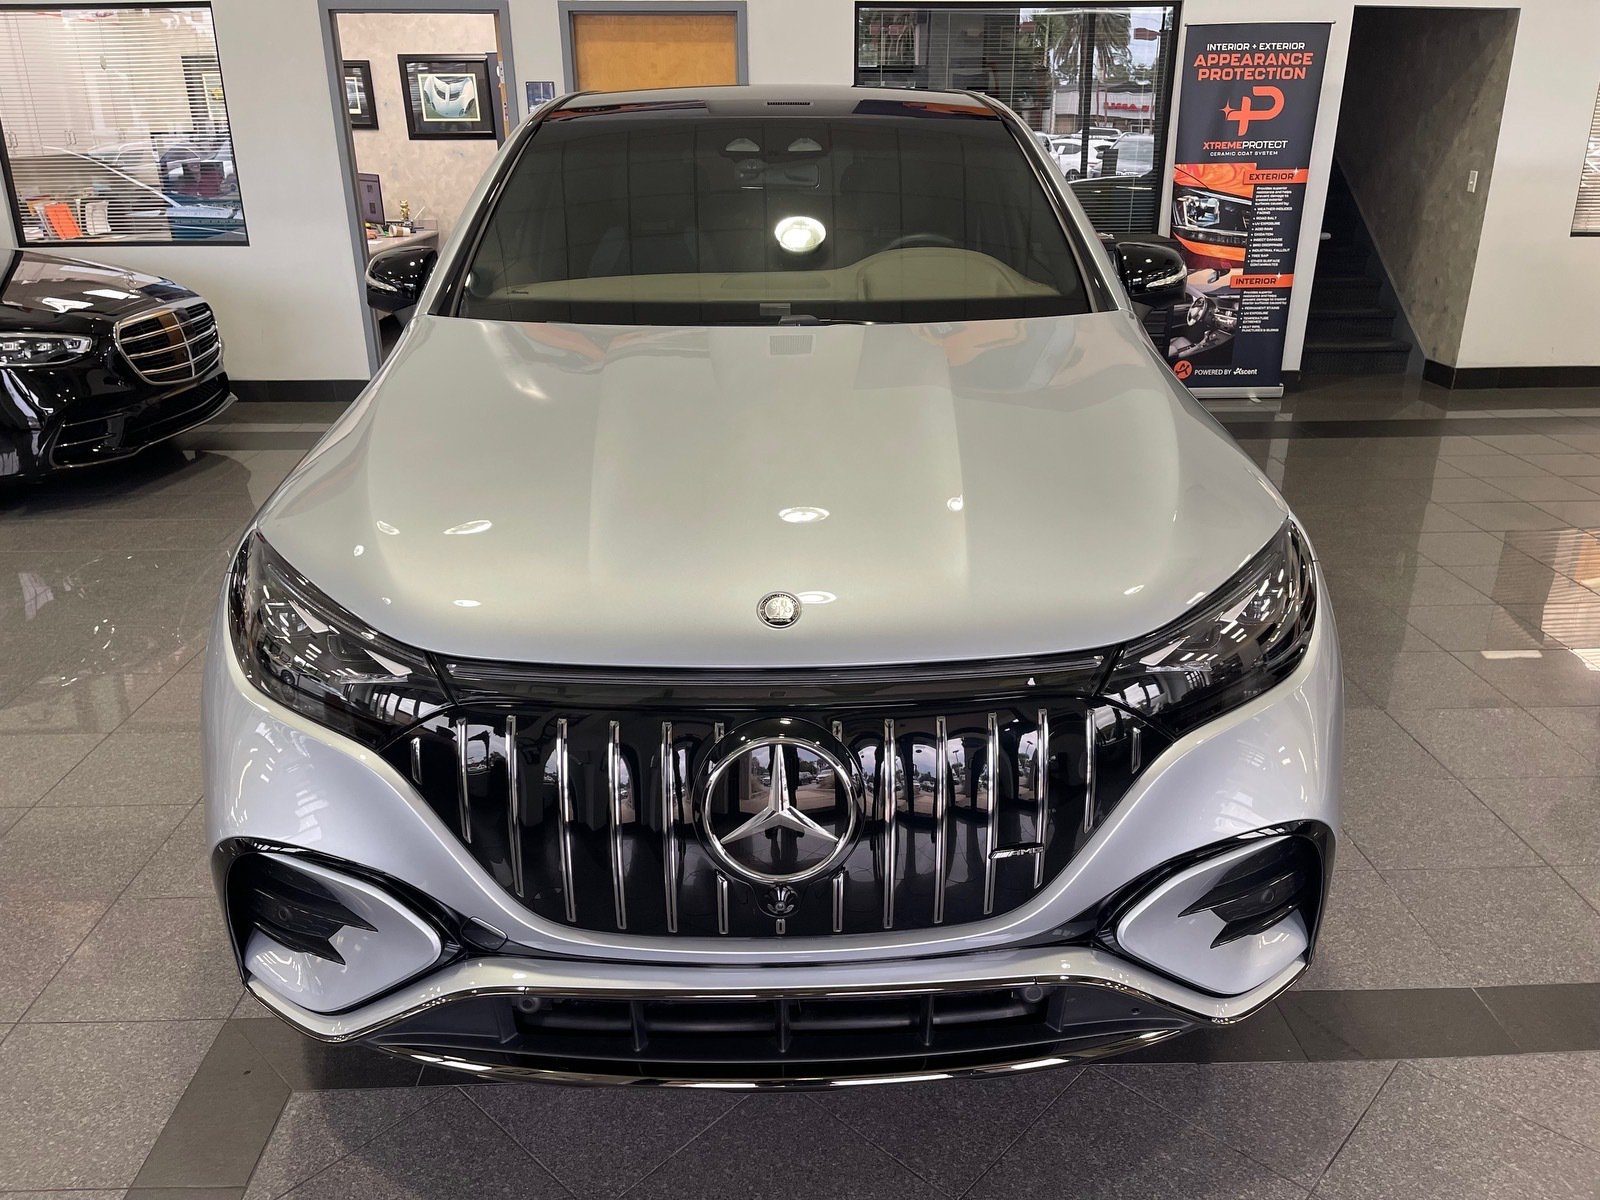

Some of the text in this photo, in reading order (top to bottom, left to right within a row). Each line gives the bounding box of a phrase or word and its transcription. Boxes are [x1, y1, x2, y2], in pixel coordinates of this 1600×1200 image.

[1206, 43, 1250, 51] INTERIOR
[1259, 42, 1306, 50] EXTERIOR
[1193, 52, 1314, 67] APPEARANCE
[1197, 67, 1307, 81] PROTECTION
[1202, 140, 1289, 150] XTREMEPROTECT
[1248, 173, 1295, 181] EXTERIOR
[1236, 277, 1277, 285] INTERIOR
[1194, 368, 1224, 376] POWERED
